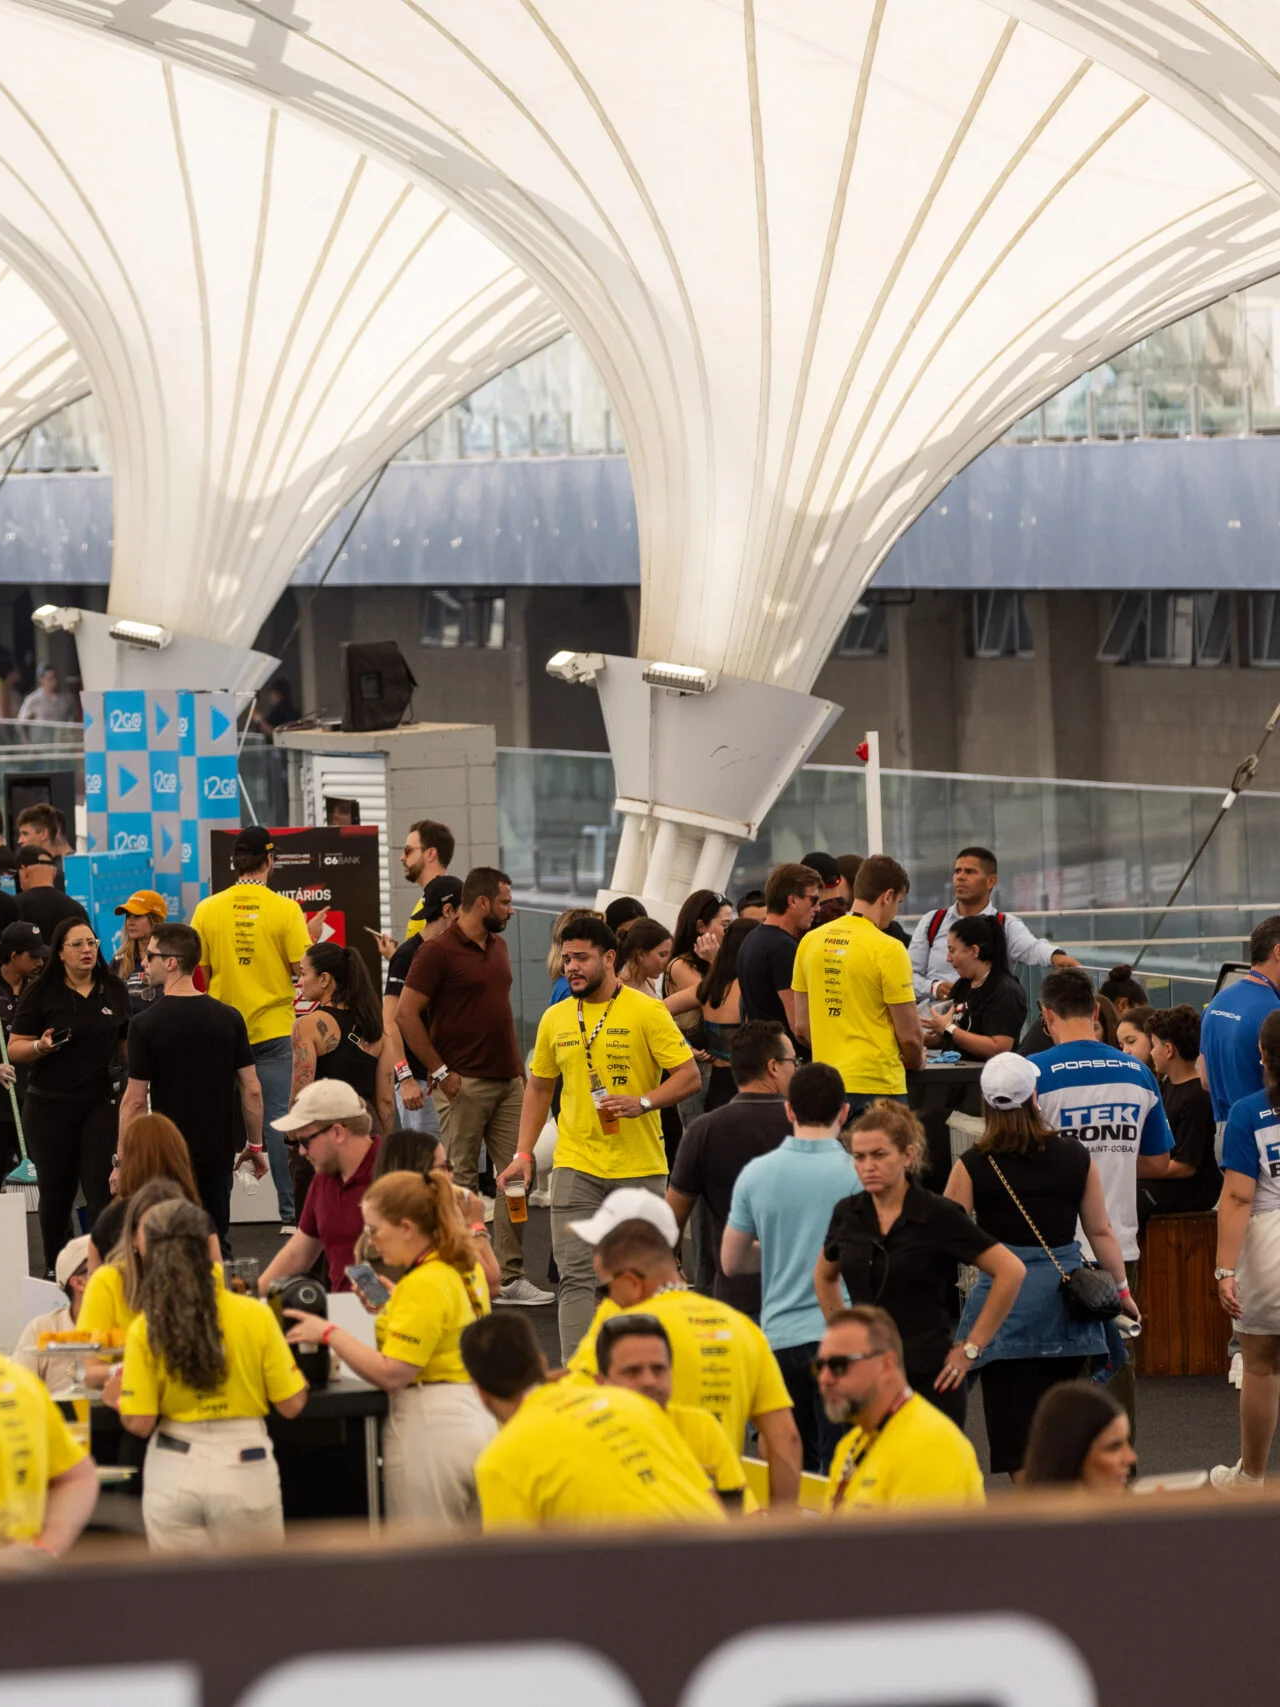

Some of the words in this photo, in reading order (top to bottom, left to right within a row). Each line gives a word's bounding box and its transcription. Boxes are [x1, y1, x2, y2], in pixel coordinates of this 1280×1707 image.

[824, 937, 850, 945] FARBEN
[1210, 1009, 1242, 1021] PORSCHE
[557, 1040, 580, 1048] FARBEN
[1050, 1060, 1142, 1073] PORSCHE
[611, 1076, 628, 1086] TIS
[1064, 1105, 1138, 1127] TEK
[1060, 1124, 1137, 1142] BOND
